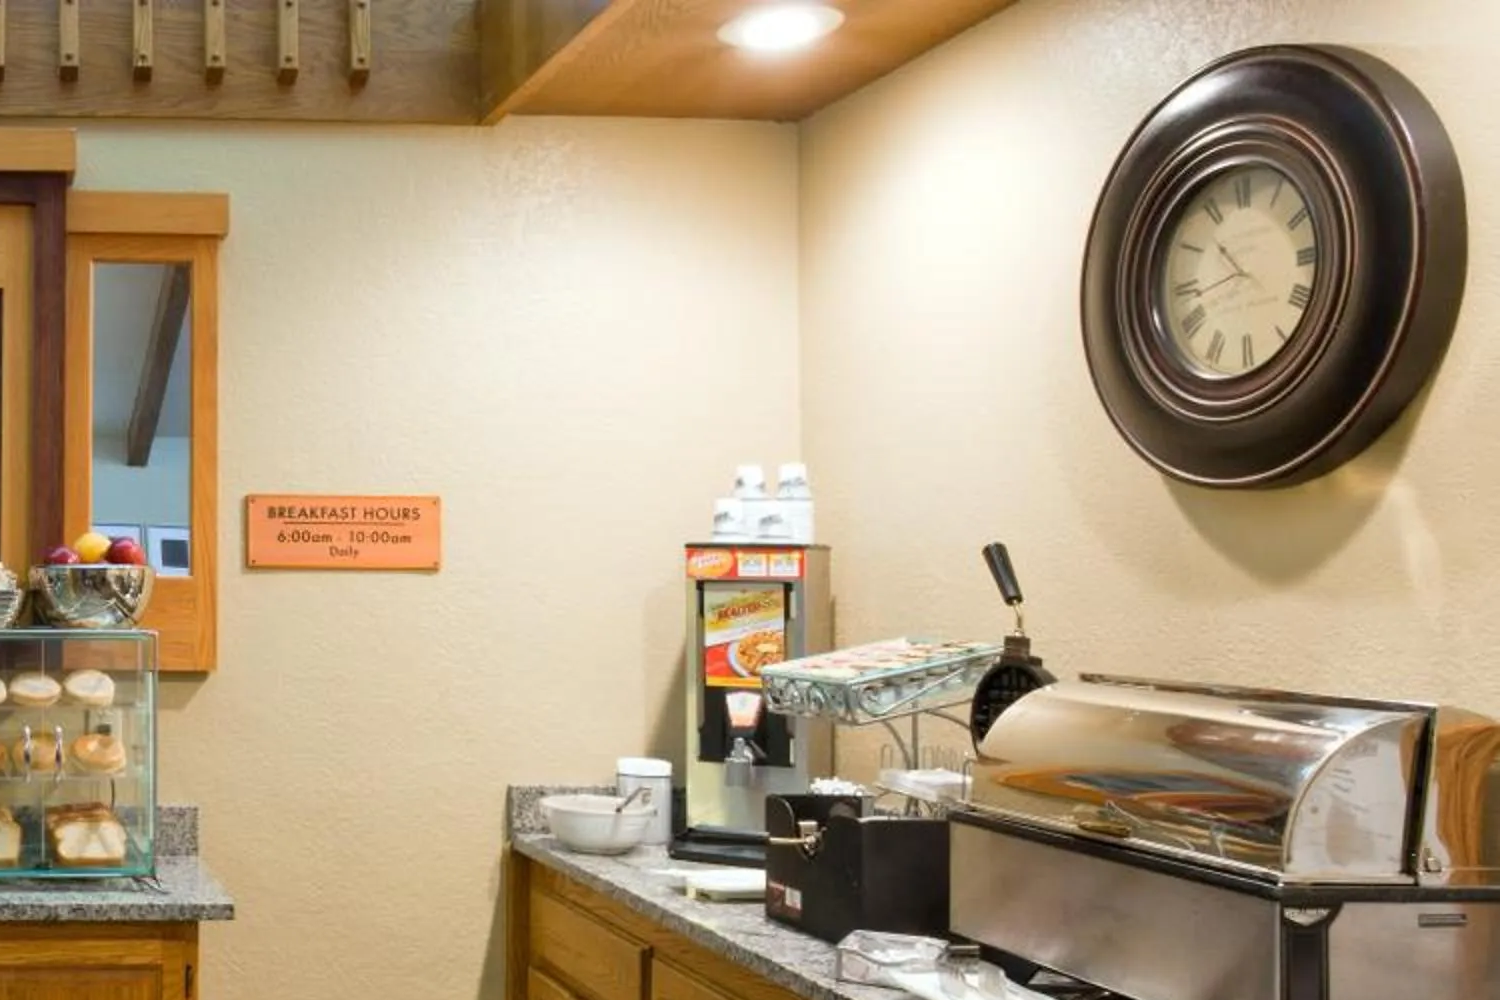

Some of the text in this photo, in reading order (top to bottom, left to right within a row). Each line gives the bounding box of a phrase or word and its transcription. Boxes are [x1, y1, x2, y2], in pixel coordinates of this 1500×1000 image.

[266, 506, 421, 521] BREAKFAST HOURS
[276, 529, 334, 543] 6:00am
[348, 530, 412, 544] 10:00am
[329, 546, 360, 559] Daily
